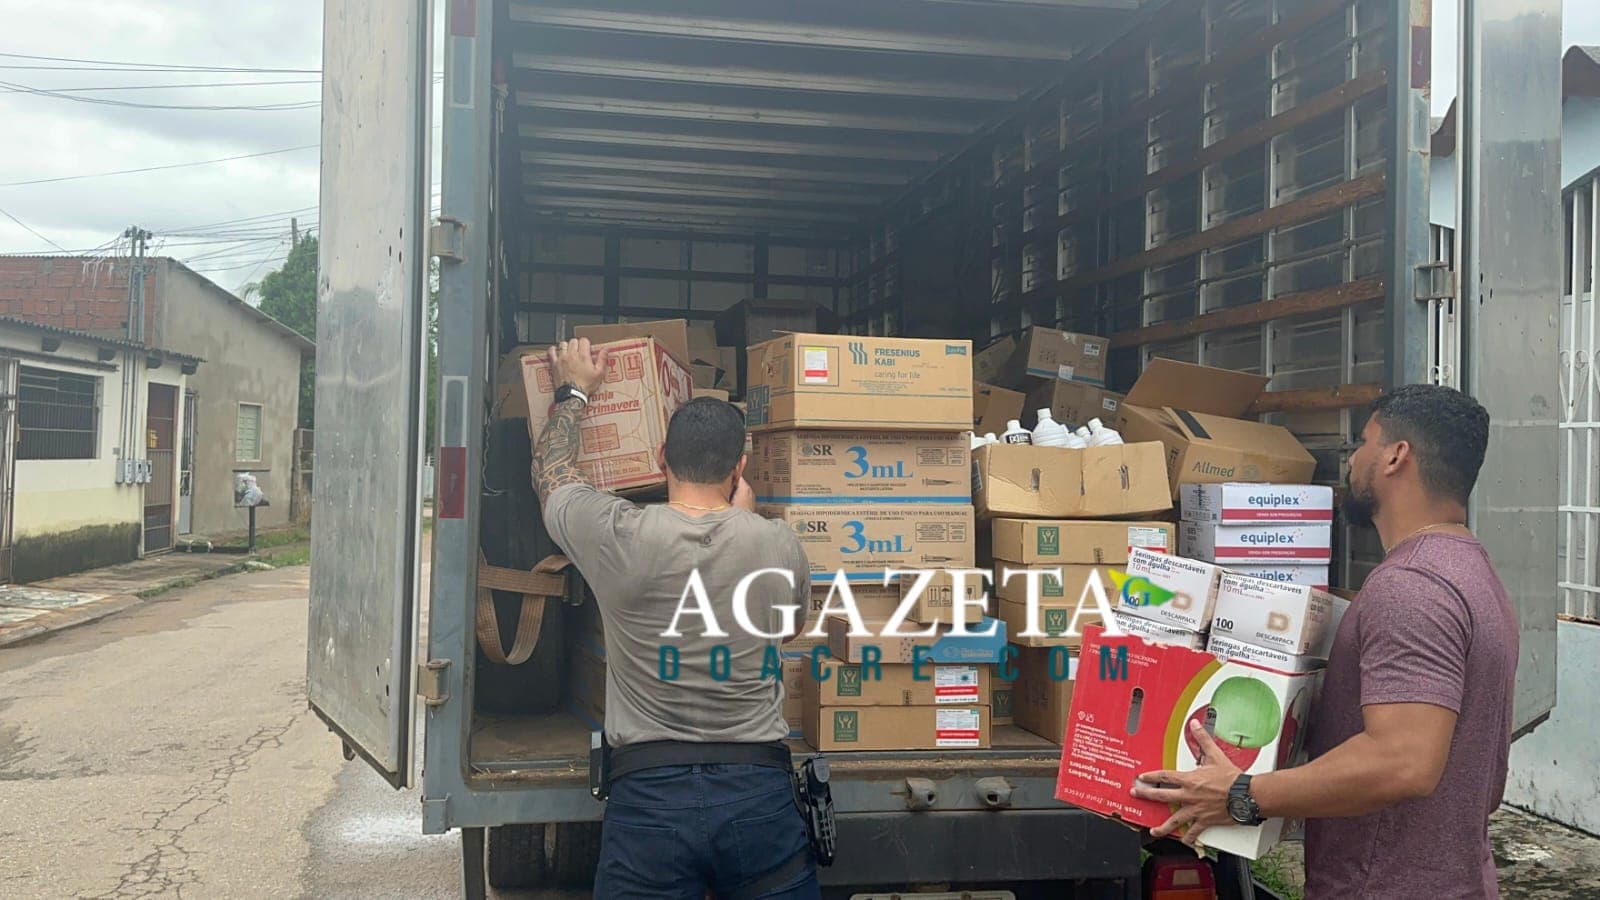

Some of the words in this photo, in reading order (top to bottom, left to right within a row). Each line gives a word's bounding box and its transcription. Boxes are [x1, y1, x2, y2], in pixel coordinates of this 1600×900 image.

[874, 348, 920, 358] FRESENIUS
[874, 358, 896, 366] KABI
[874, 371, 896, 380] caring
[897, 370, 908, 379] for
[909, 370, 921, 379] life
[586, 399, 640, 415] Primavera
[813, 444, 833, 456] SR
[1192, 461, 1236, 477] Allmed
[1248, 493, 1300, 507] equiplex
[807, 520, 828, 533] SR
[1240, 532, 1295, 545] equiplex
[1132, 557, 1147, 565] com
[1134, 550, 1162, 563] Seringas
[1163, 557, 1206, 574] descartáveis
[1223, 578, 1238, 586] com
[1160, 609, 1197, 625] DESCARPACK
[1215, 617, 1234, 630] 100
[1256, 631, 1294, 645] DESCARPACK
[1210, 645, 1225, 653] com
[1211, 637, 1240, 650] Seringas
[1242, 644, 1288, 662] descartáveis
[1069, 760, 1100, 774] Exporters
[1068, 768, 1092, 780] Packers
[1107, 799, 1122, 810] fruit
[1124, 804, 1142, 817] fresh
